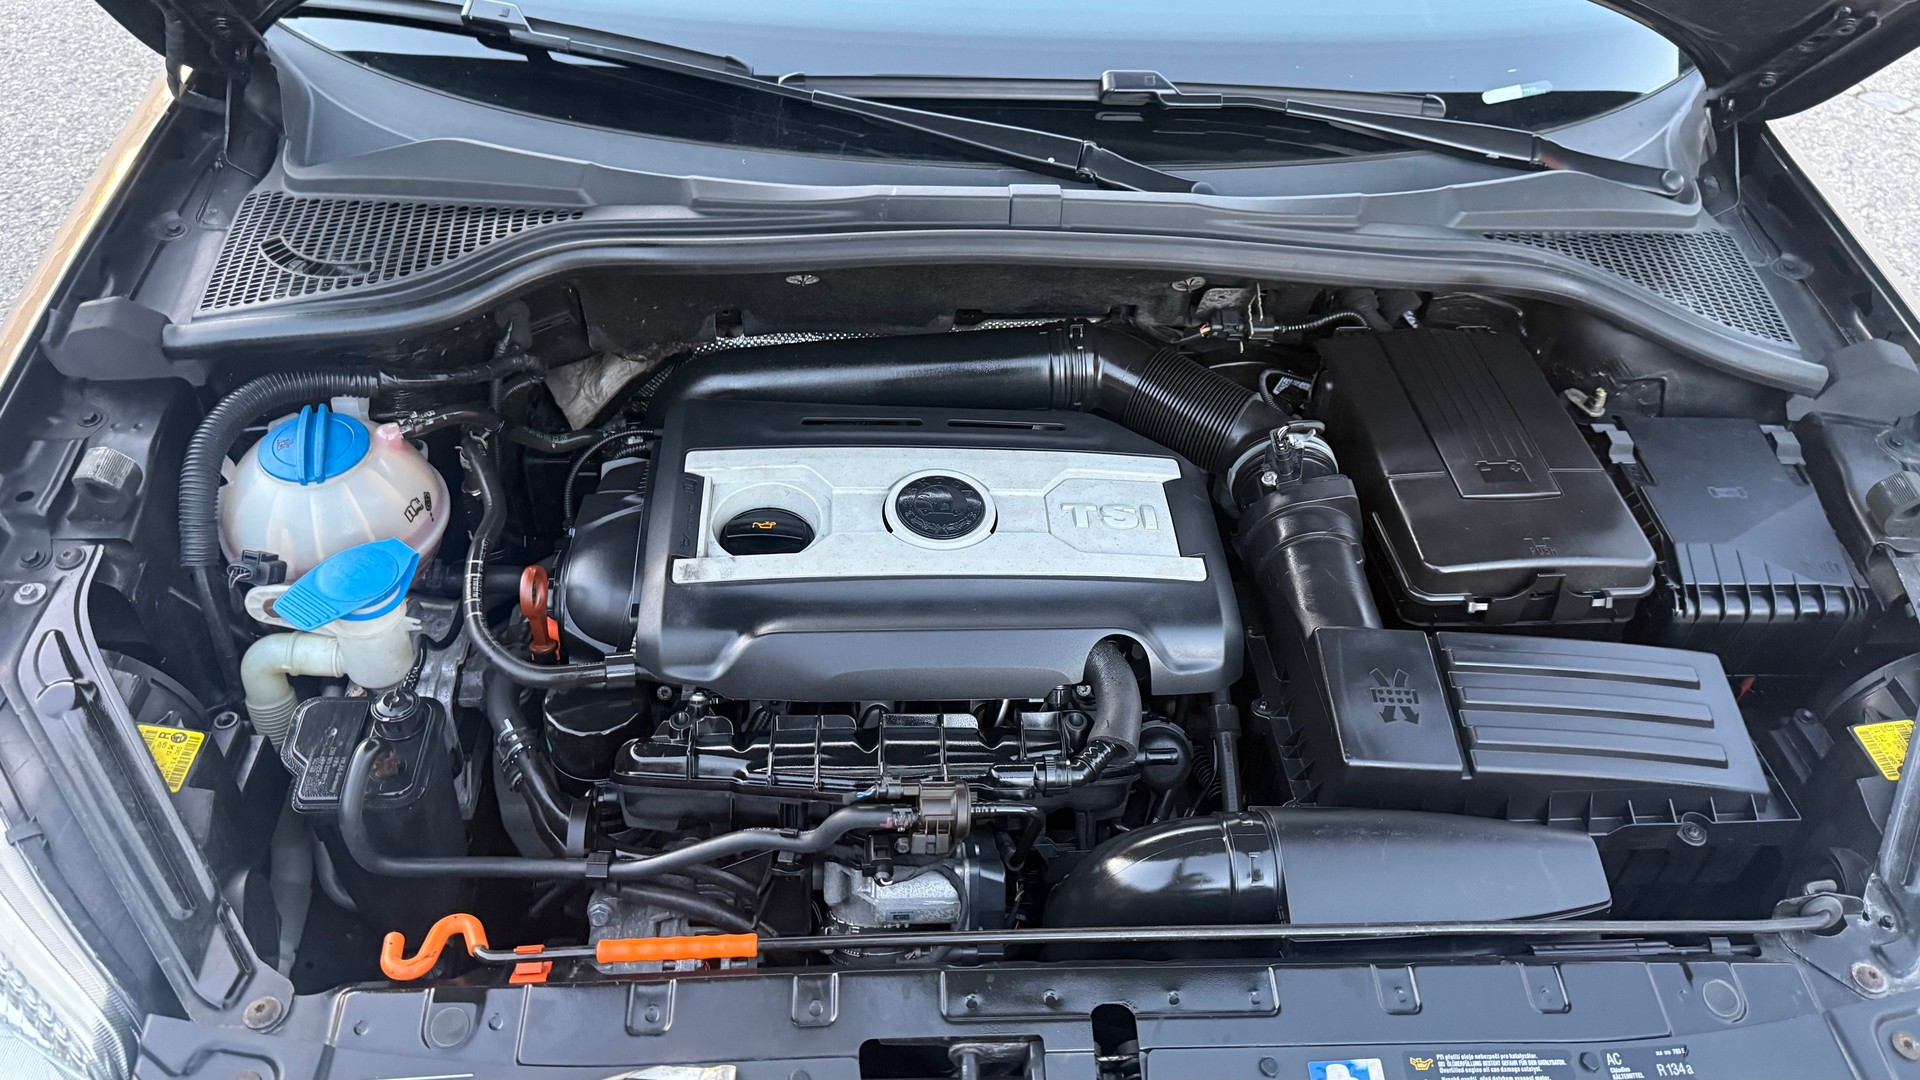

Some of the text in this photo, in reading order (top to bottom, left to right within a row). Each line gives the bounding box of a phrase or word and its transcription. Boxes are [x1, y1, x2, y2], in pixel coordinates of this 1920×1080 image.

[1060, 503, 1158, 530] TSI
[1530, 546, 1557, 556] PUSH
[158, 731, 171, 739] R
[1607, 1053, 1622, 1066] AC
